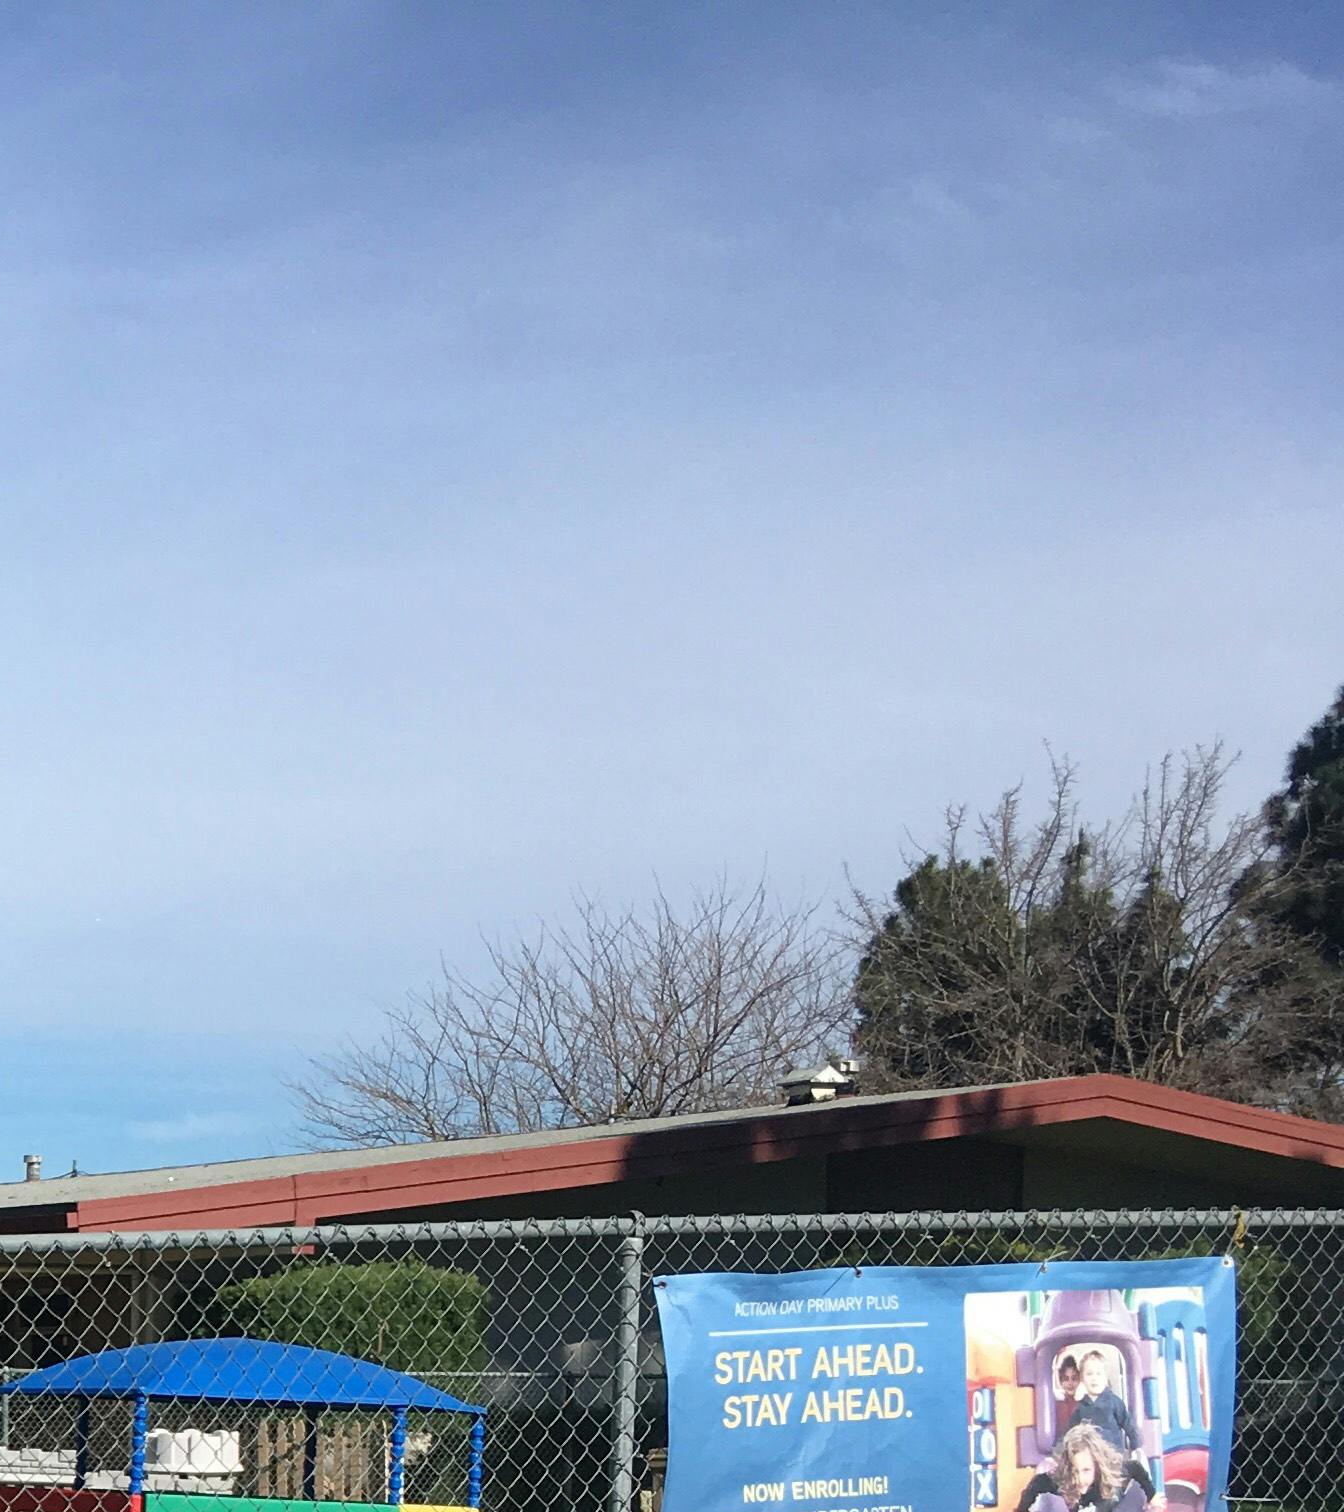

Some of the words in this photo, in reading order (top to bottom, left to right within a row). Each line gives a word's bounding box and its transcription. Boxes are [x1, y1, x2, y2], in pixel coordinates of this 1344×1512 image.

[735, 1301, 777, 1317] ACTION
[780, 1299, 804, 1315] DAY
[807, 1297, 863, 1313] PRIMARY
[866, 1295, 899, 1310] PLUS
[714, 1347, 802, 1385] START
[811, 1342, 924, 1379] AHEAD.
[722, 1392, 793, 1428] STAY
[800, 1386, 913, 1424] AHEAD.
[743, 1483, 784, 1503] NOW
[791, 1475, 889, 1500] ENROLLING!
